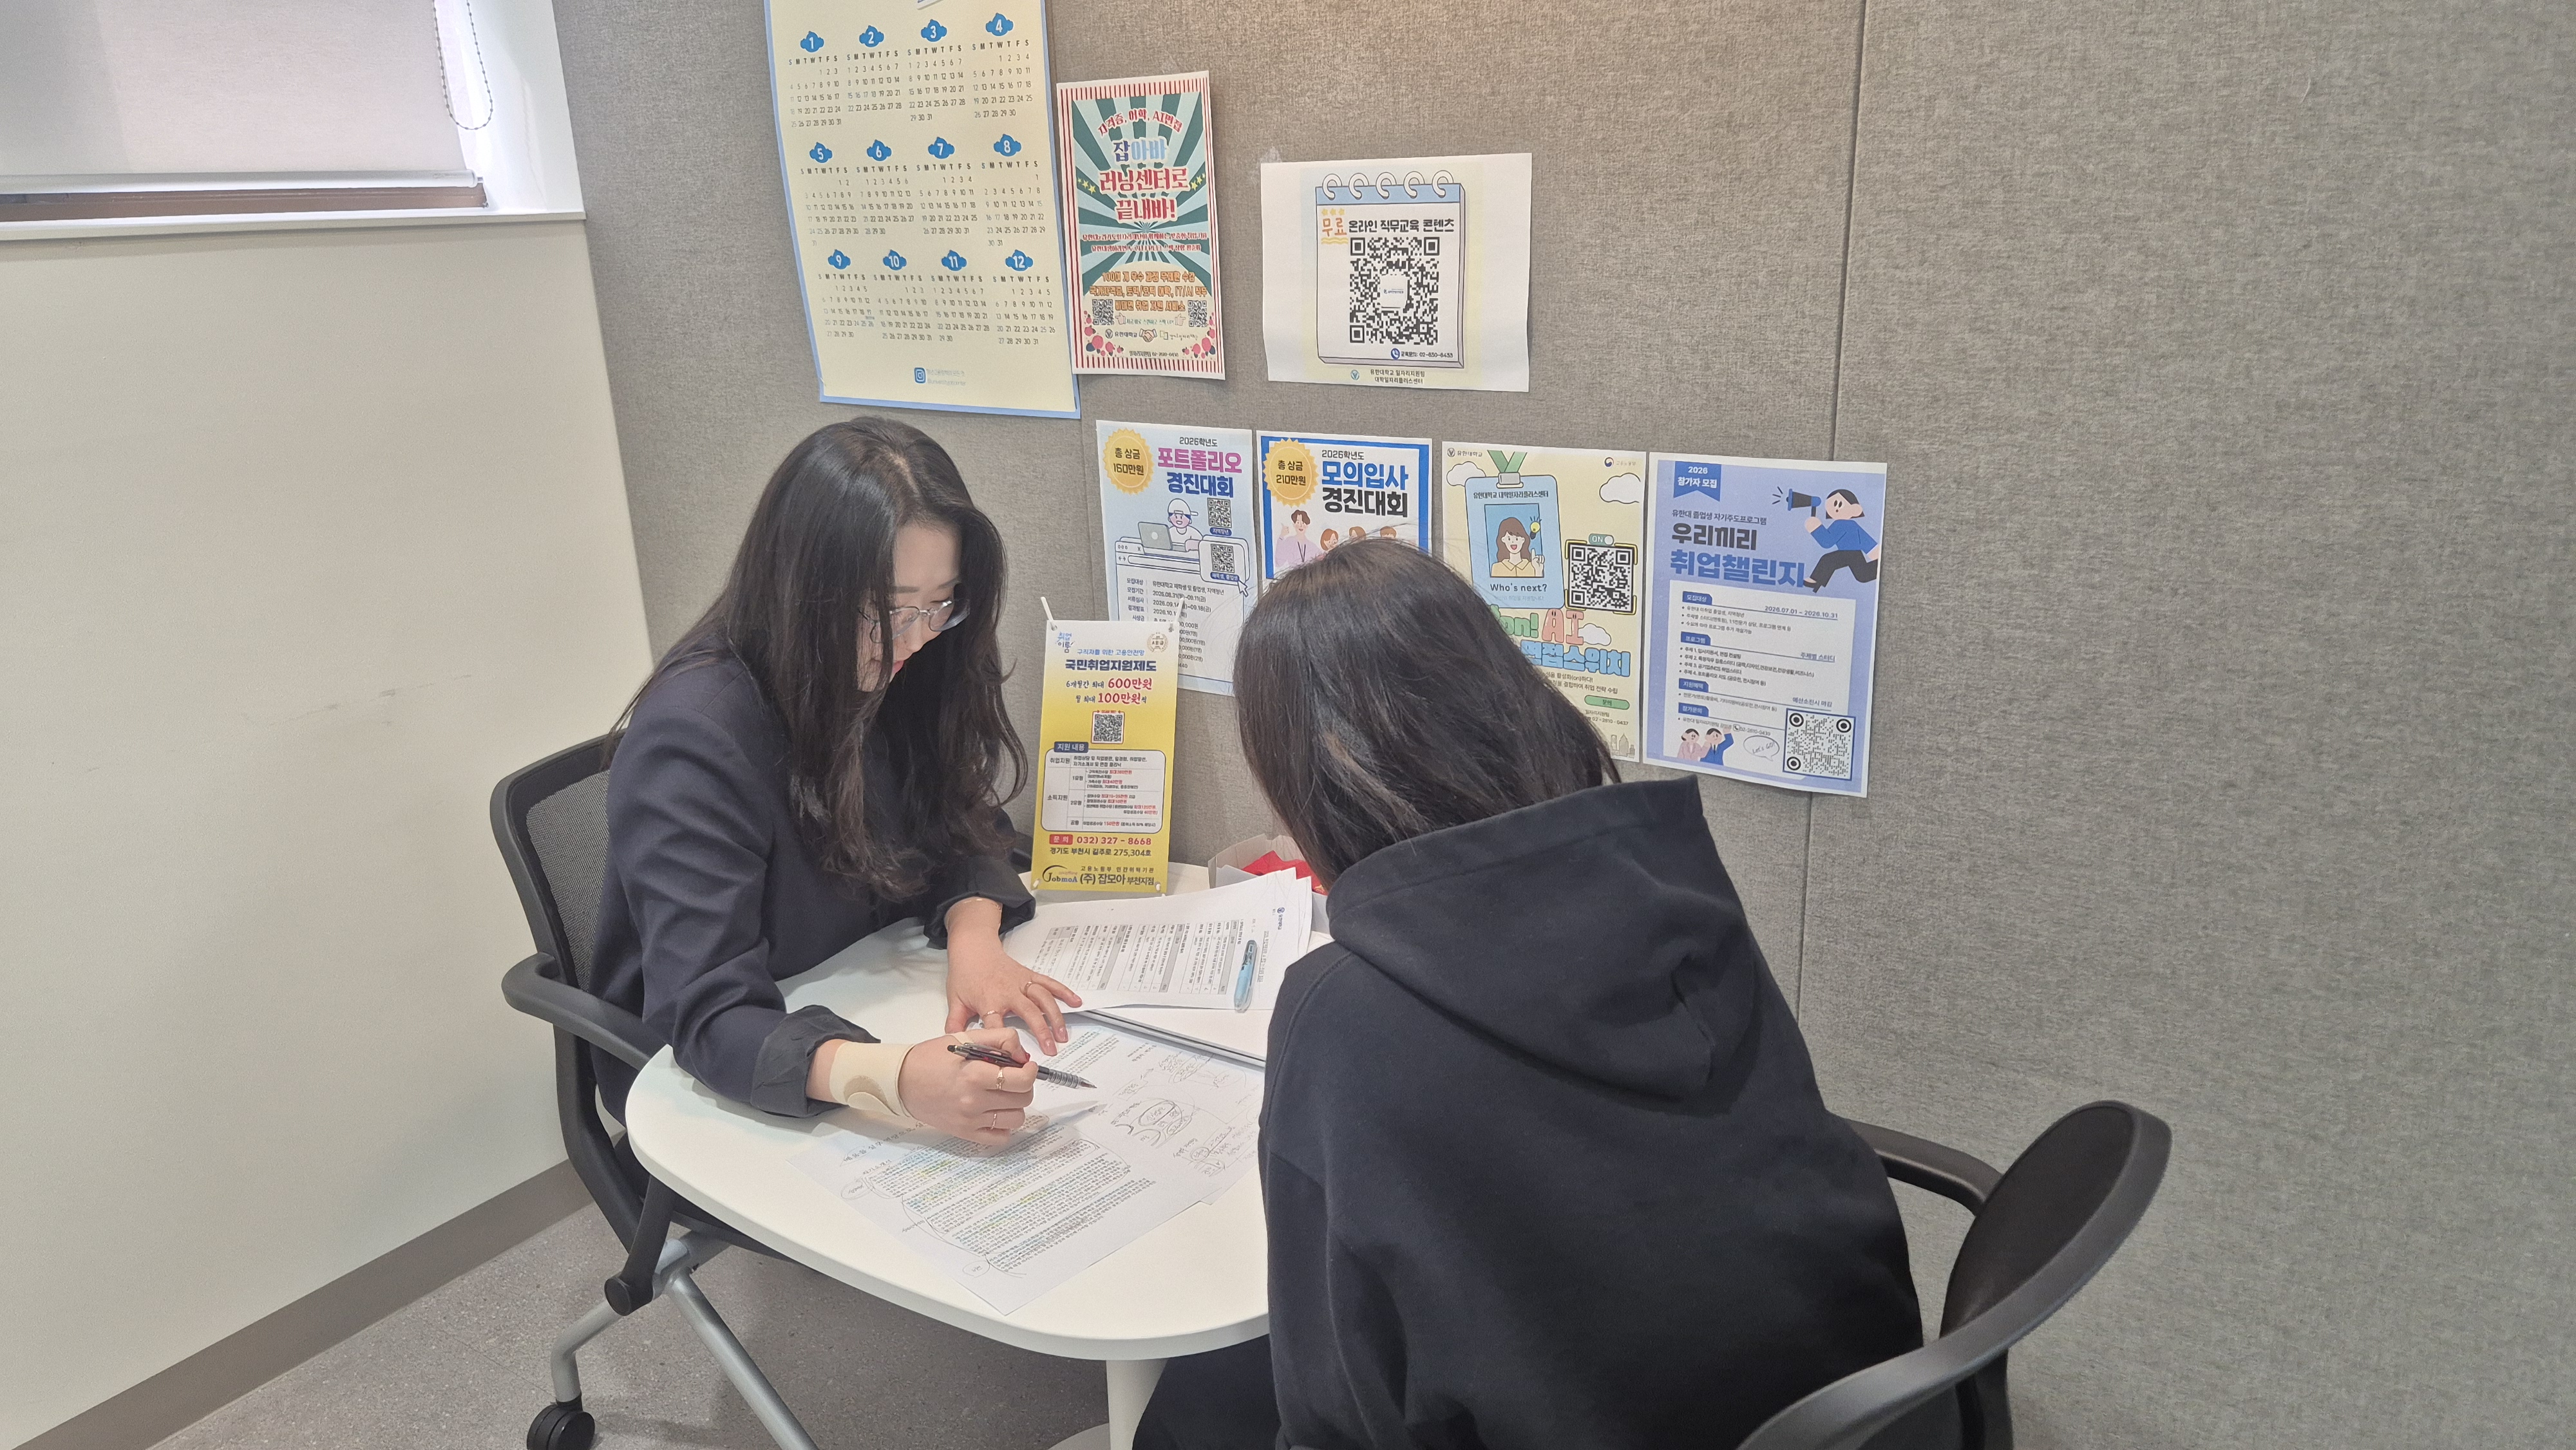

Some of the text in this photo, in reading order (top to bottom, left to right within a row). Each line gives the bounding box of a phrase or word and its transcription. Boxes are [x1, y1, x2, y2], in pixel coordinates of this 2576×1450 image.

[809, 19, 1003, 50] 1 2 3 4
[1098, 108, 1182, 136] 자격증, 어학, AI면접
[817, 140, 1010, 160] 5 6 7 8
[1113, 138, 1167, 162] 잡아바
[1100, 168, 1188, 191] 러닝센터로
[1116, 198, 1175, 220] 끝내바!
[1321, 218, 1454, 237] 무료 온라인 직무교육 콘텐츠
[835, 255, 1025, 268] 9 10 11 12
[1122, 271, 1195, 283] 개 우수 과정 무제한 수강
[1090, 285, 1125, 297] 국가자격증,
[1158, 286, 1173, 297] 어학,
[1175, 286, 1194, 297] IT/AI
[1195, 286, 1207, 297] 직무
[1115, 300, 1186, 311] 비대면 취업 지원 서비스
[1179, 437, 1218, 447] 2026학년도
[1115, 447, 1141, 460] 총 상금
[1158, 447, 1242, 473] 포트폴리오
[1322, 450, 1365, 460] 2026학년도
[1113, 463, 1144, 475] 160만원
[1278, 460, 1303, 471] 총 상금
[1688, 466, 1708, 475] 2026
[1276, 475, 1306, 486] 210만원
[1321, 461, 1409, 491] 모의입사
[1677, 476, 1717, 489] 참가자 모집
[1167, 472, 1234, 498] 경진대회
[1322, 487, 1408, 518] 경진대회
[1672, 509, 1767, 526] 유한대 졸업생 자기주도프로그램
[1592, 535, 1604, 543] ON
[1672, 522, 1757, 551] 우리끼리
[1670, 549, 1806, 588] 취업챌린지
[1490, 583, 1548, 592] Who's next?
[1542, 608, 1584, 645] AI
[1065, 659, 1157, 672] 국민취업지원제도
[1066, 678, 1152, 690] 6개월간 최대 600만원
[1075, 695, 1081, 703] 월
[1113, 849, 1151, 857] 275,304호
[1043, 872, 1077, 883] JobmoA
[1080, 874, 1154, 885] (주) 잡모아 부천지점
